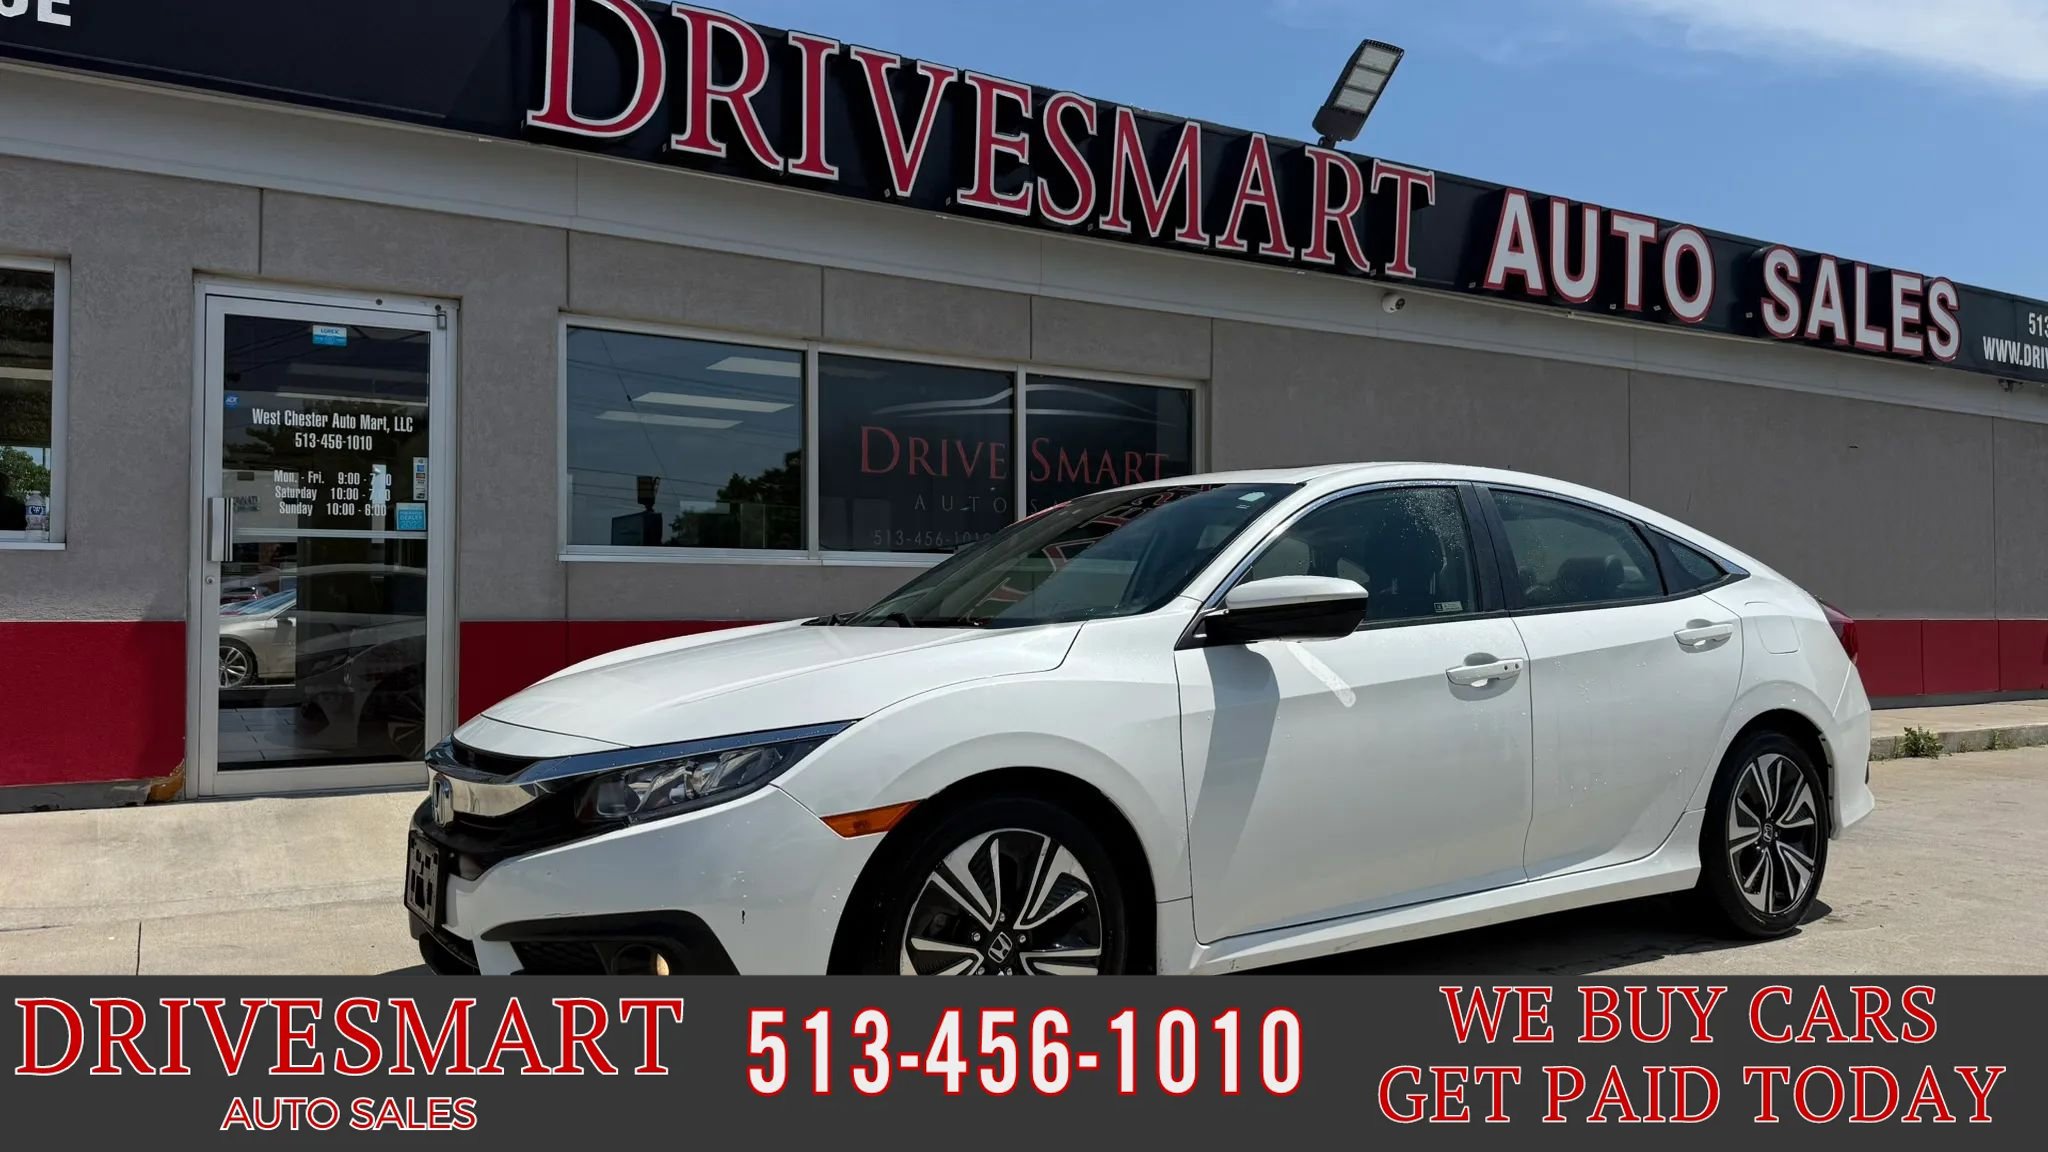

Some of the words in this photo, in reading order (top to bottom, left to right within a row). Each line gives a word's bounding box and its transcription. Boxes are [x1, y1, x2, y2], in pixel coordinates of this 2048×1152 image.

[526, 0, 1435, 279] DRIVESMART
[1484, 188, 1716, 323] AUTO
[1760, 244, 1961, 362] SALES
[252, 408, 281, 426] West
[284, 409, 328, 428] Chester
[332, 413, 356, 430] Auto
[360, 414, 390, 434] Mart,
[394, 416, 413, 432] LLC
[295, 432, 373, 451] 513-456-1010
[860, 426, 1008, 480] DRIVE
[1030, 437, 1169, 486] SMART
[273, 470, 297, 483] Mon.
[308, 471, 325, 484] Fri.
[338, 471, 360, 485] 9:00
[275, 485, 317, 501] Saturday
[330, 487, 359, 500] 10:00
[279, 501, 313, 516] Sunday
[326, 502, 355, 515] 10:00
[364, 503, 387, 516] 6:00
[914, 494, 1007, 514] AUTO
